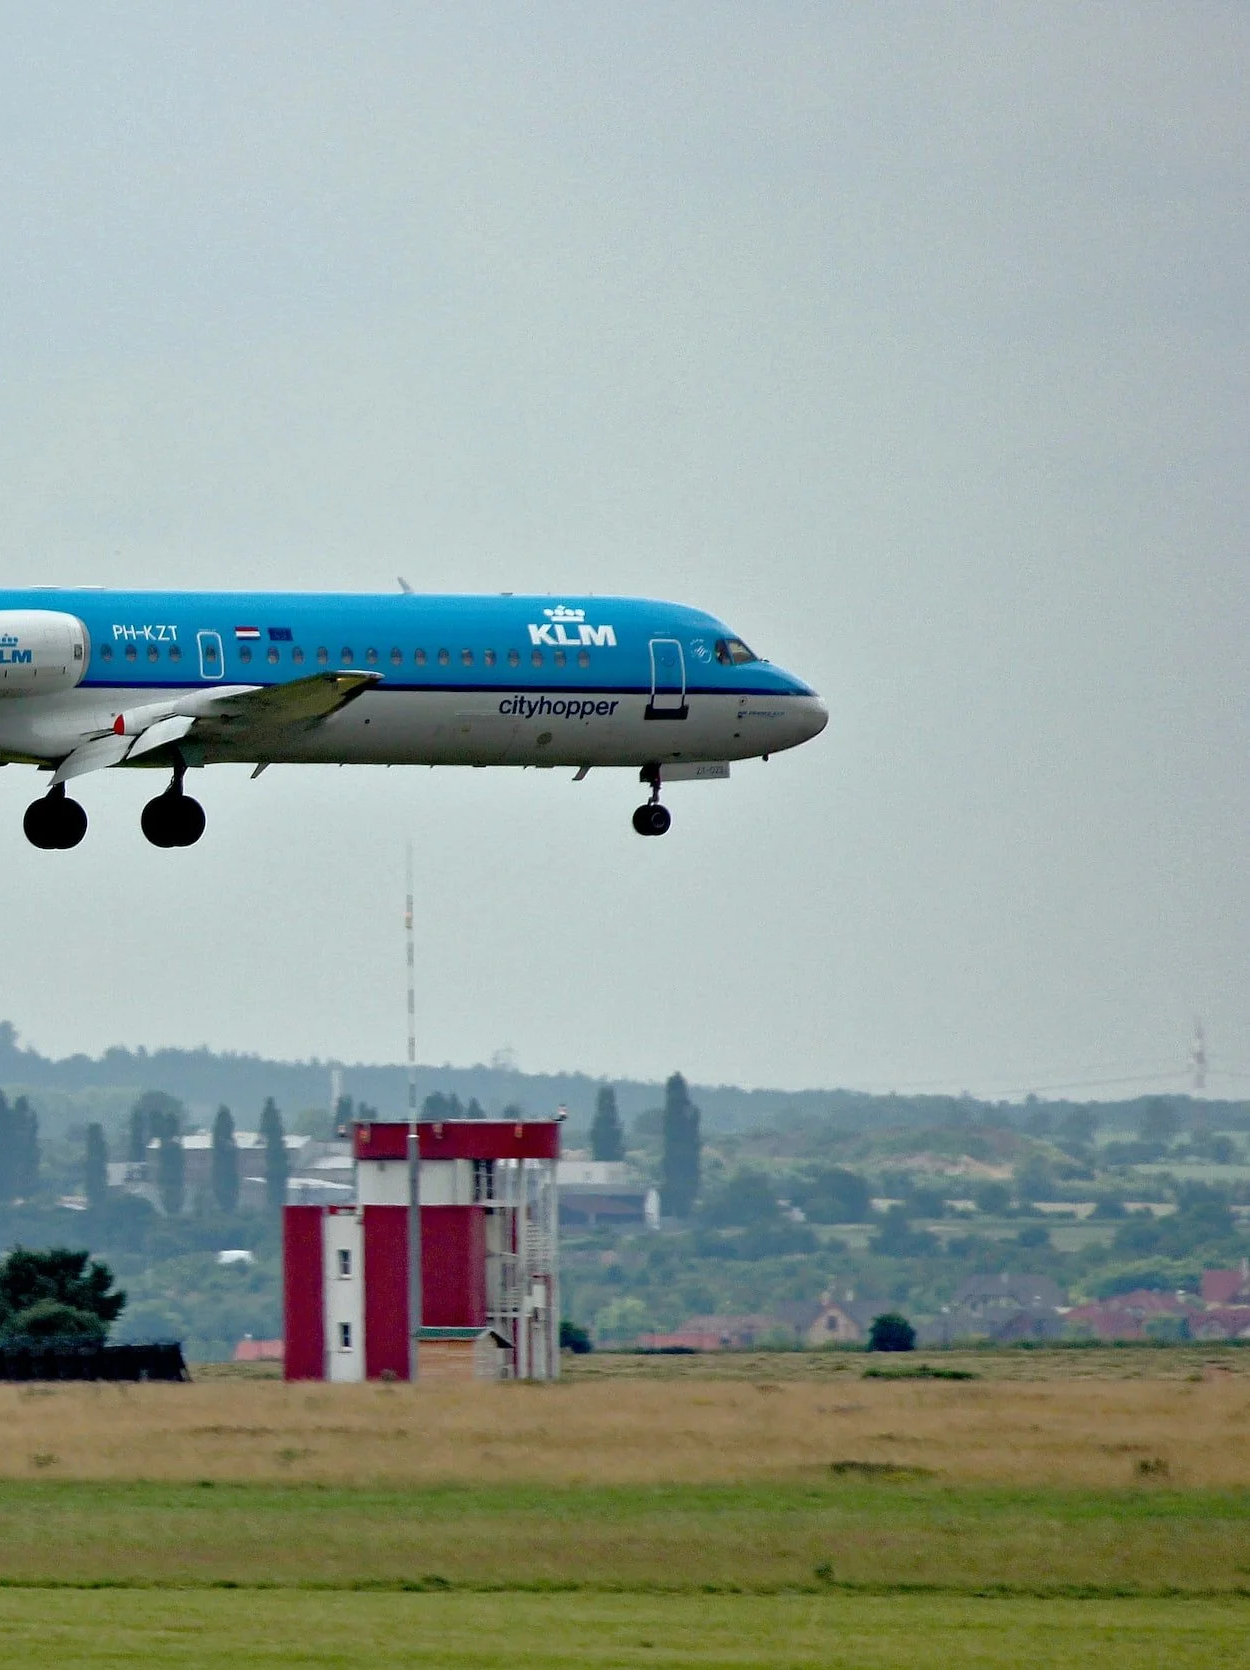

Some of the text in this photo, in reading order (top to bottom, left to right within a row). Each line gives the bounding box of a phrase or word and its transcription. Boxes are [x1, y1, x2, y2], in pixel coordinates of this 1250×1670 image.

[112, 625, 177, 641] PH-KZT
[528, 624, 617, 646] KLM
[499, 695, 619, 719] cityhopper
